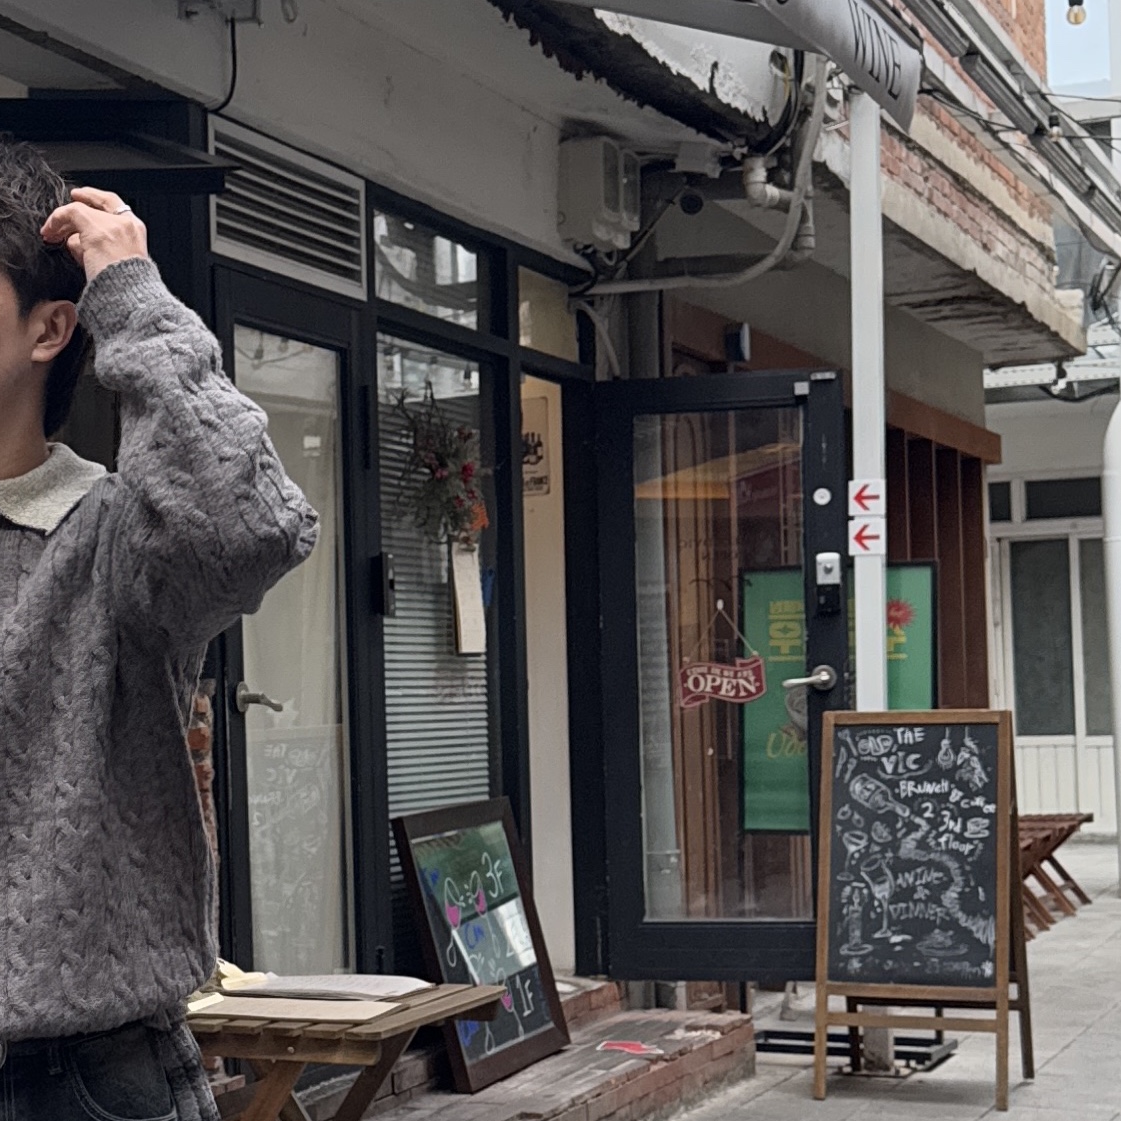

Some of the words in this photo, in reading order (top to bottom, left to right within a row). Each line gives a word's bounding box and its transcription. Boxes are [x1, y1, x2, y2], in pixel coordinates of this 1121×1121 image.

[847, 0, 902, 101] WINE
[687, 673, 757, 697] OPEN
[881, 751, 923, 775] VIC
[481, 852, 504, 898] 3F
